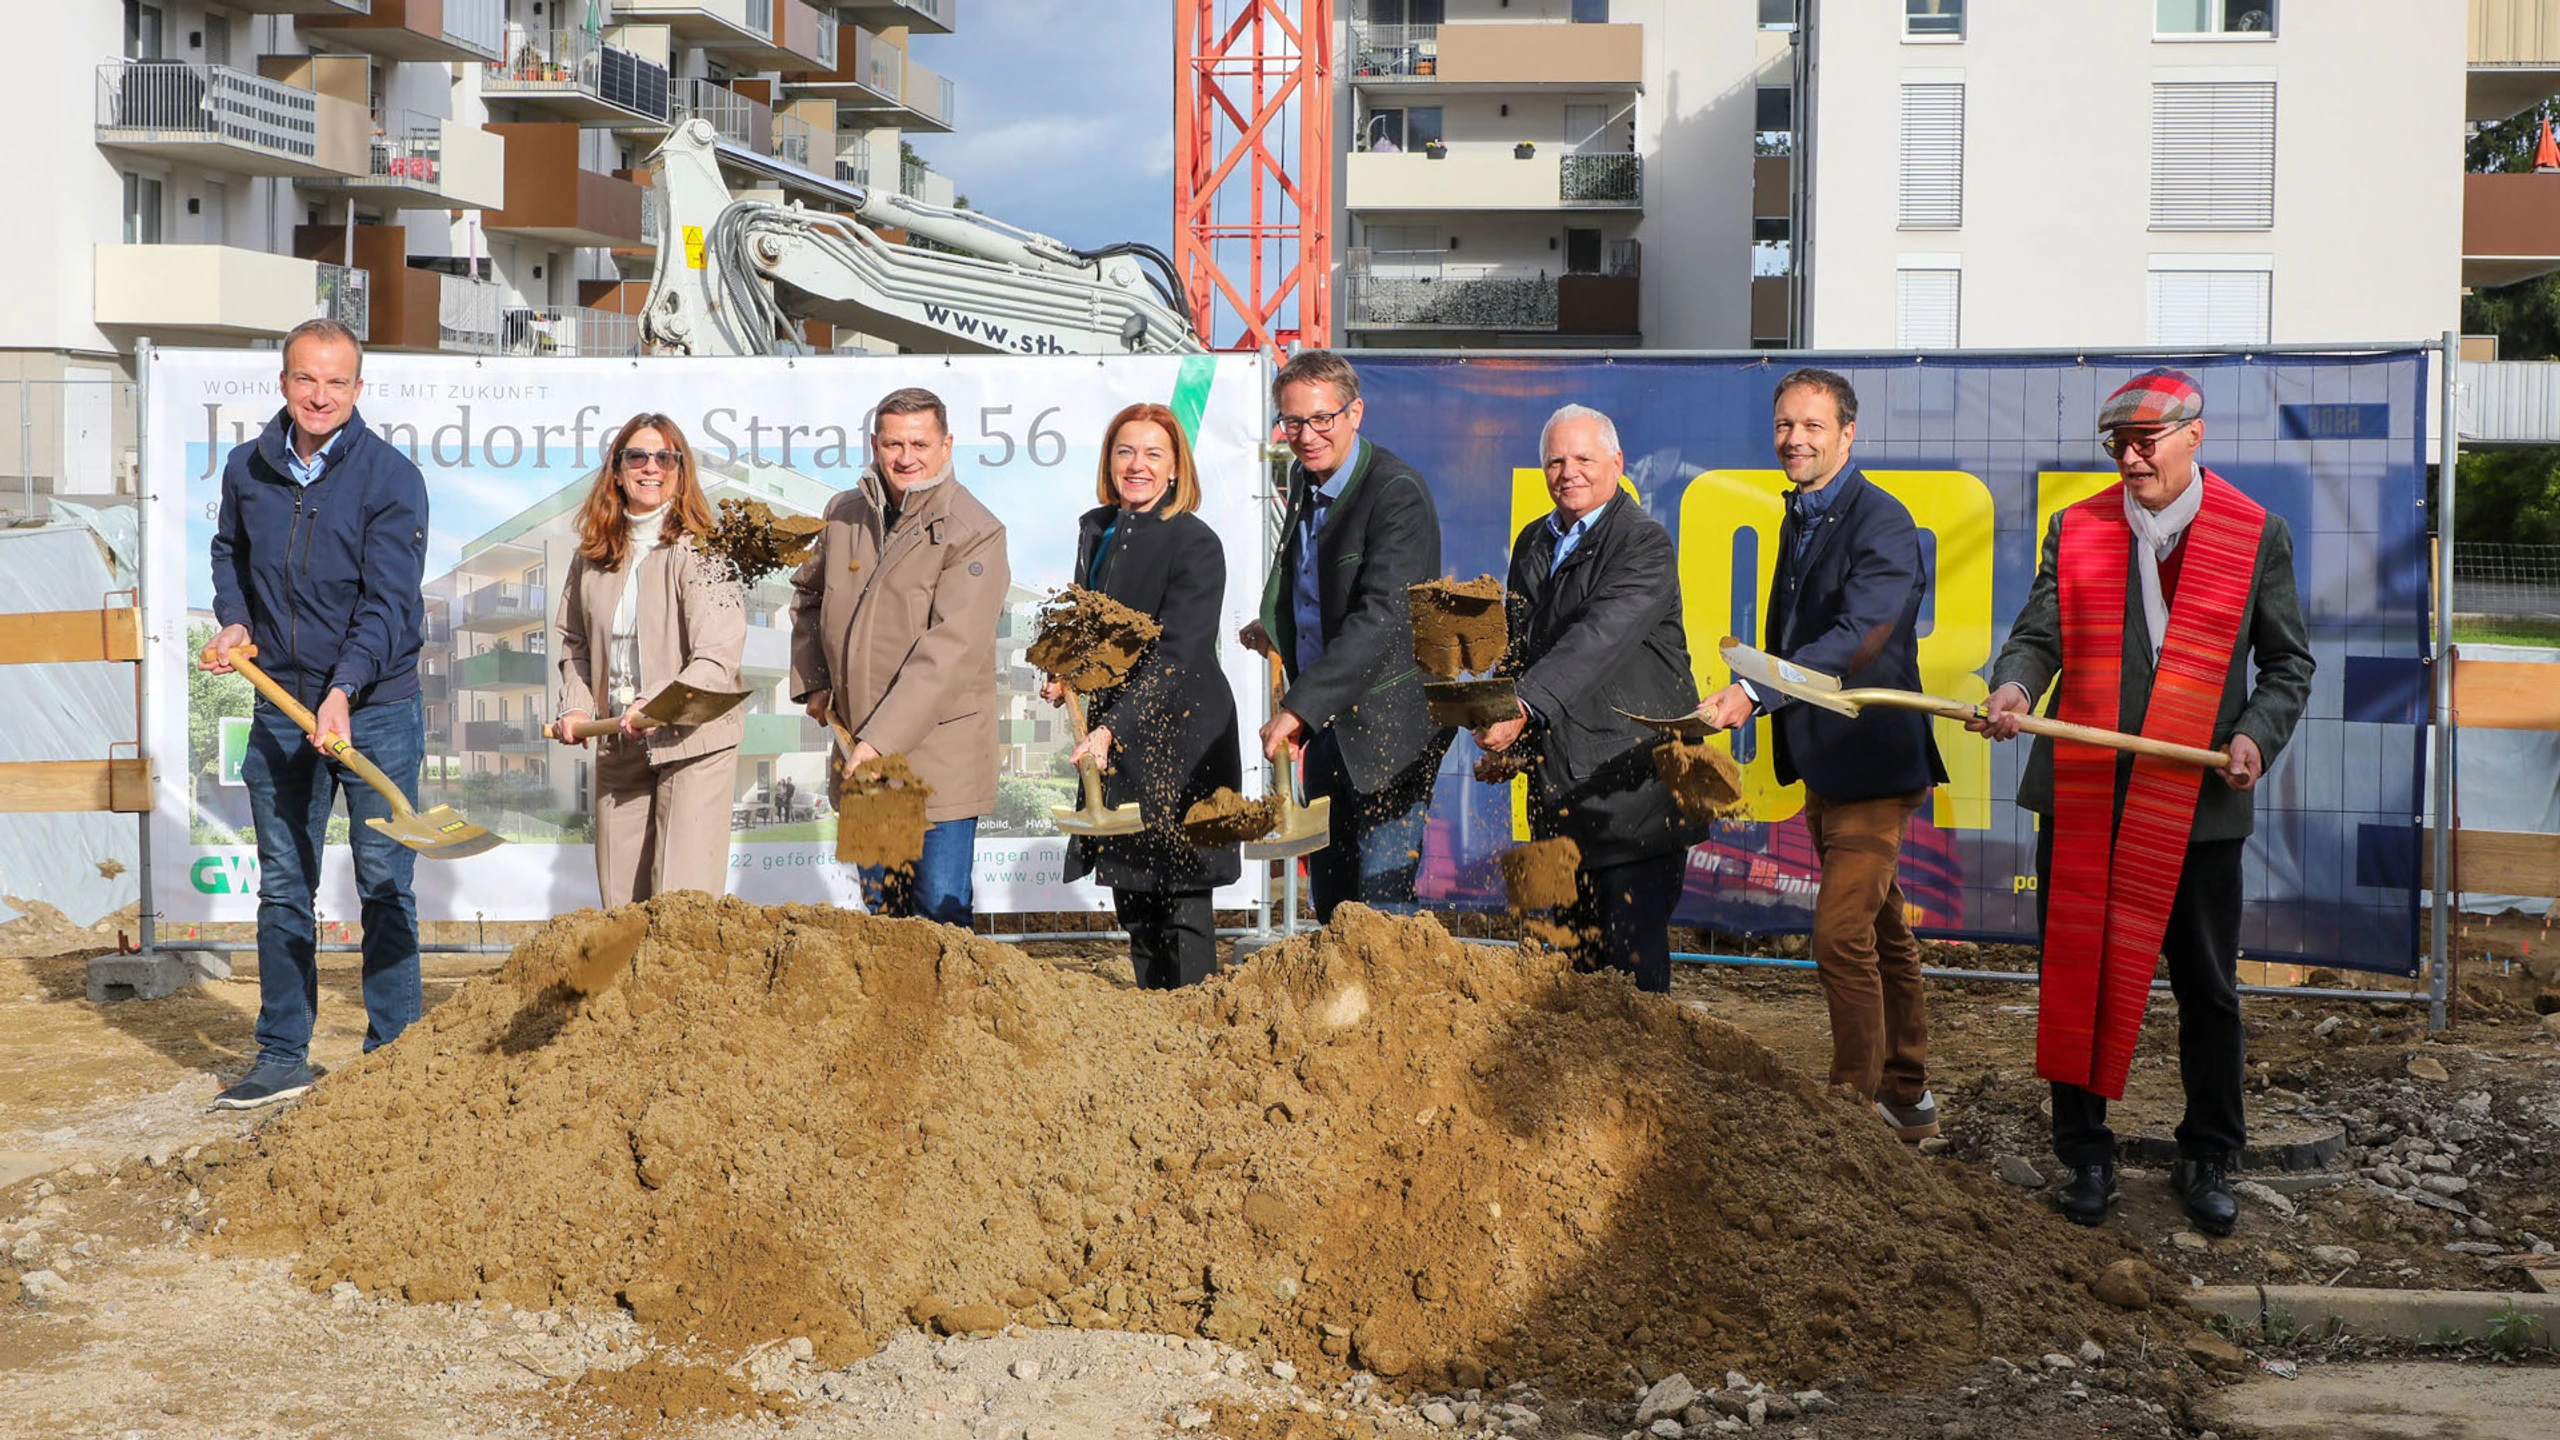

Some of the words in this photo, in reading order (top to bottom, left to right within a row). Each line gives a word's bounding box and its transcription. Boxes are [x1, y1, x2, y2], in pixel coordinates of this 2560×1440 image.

[401, 384, 437, 398] MIT
[448, 386, 549, 399] ZUKUNFT
[702, 406, 877, 469] Stra
[977, 405, 1067, 468] 56
[730, 854, 752, 867] 22
[762, 852, 837, 870] geförde
[190, 857, 262, 894] GW
